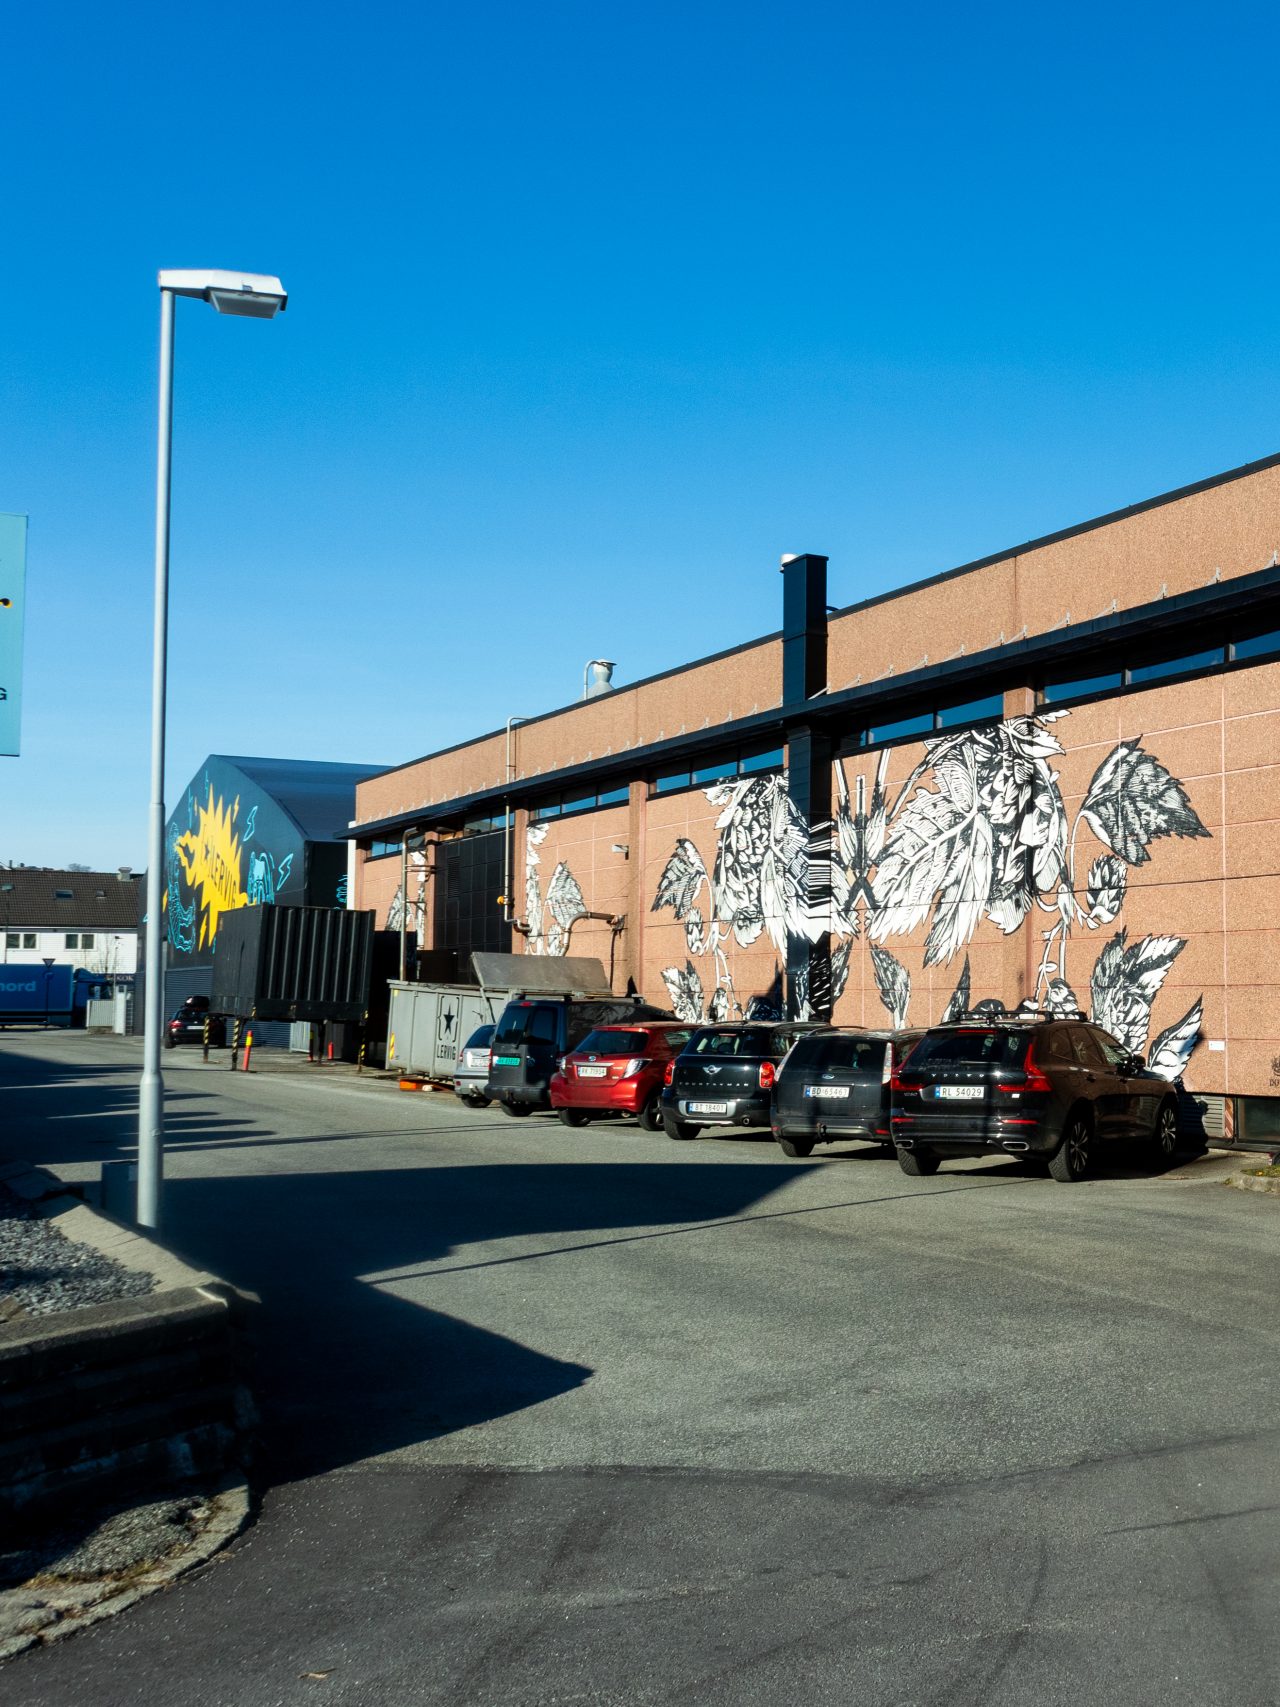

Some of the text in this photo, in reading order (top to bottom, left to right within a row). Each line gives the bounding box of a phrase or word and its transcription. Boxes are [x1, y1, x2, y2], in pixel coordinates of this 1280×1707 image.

[437, 1044, 456, 1060] LERVIG
[812, 1087, 821, 1095] BD
[942, 1087, 981, 1097] RL 54029
